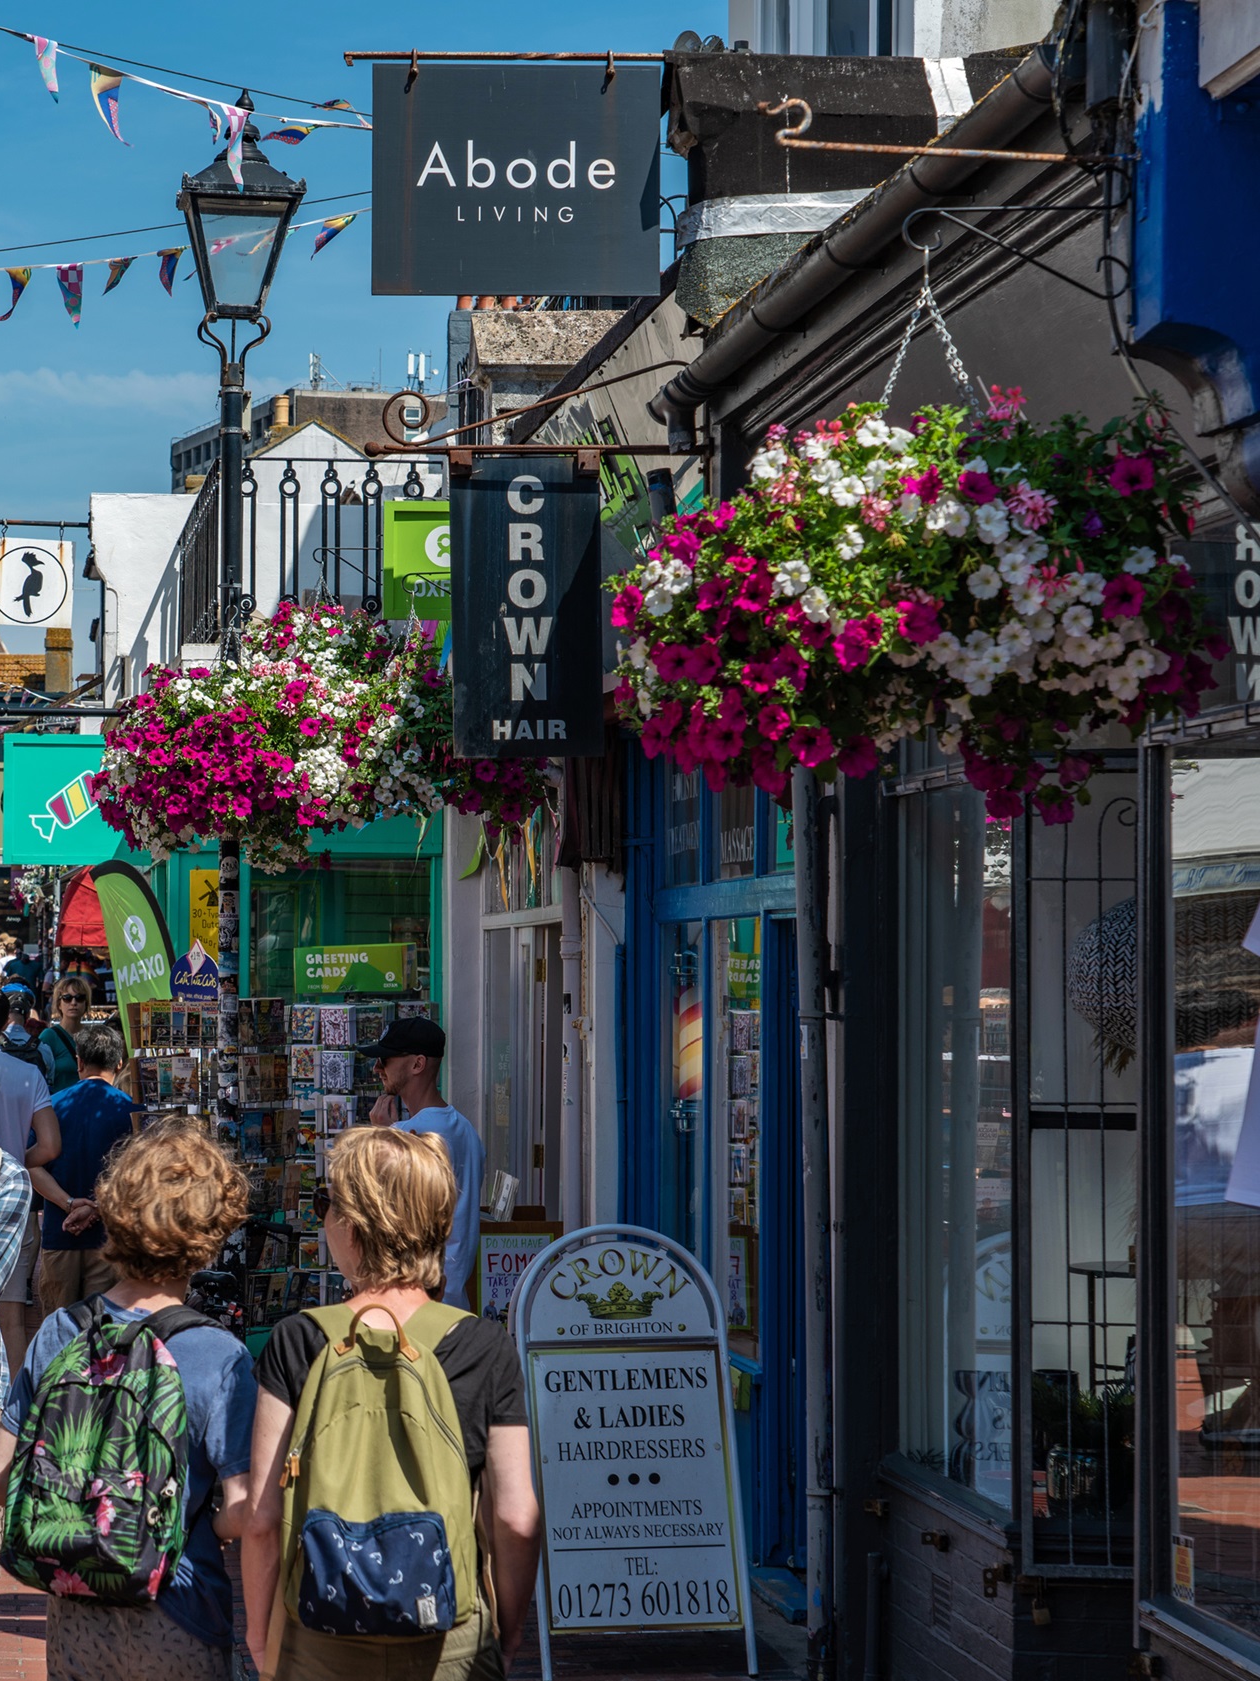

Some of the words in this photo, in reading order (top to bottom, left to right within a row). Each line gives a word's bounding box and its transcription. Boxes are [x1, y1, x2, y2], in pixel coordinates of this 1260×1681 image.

[416, 139, 616, 189] Abode
[457, 206, 574, 223] LIVING
[414, 579, 451, 598] OXF
[503, 475, 553, 700] CROWN
[492, 719, 567, 740] HAIR
[720, 826, 755, 864] MASSAGE
[305, 952, 369, 965] GREETING
[306, 967, 347, 978] CARDS
[486, 1237, 498, 1249] DO
[501, 1237, 518, 1249] YOU
[521, 1237, 543, 1248] HAVE
[486, 1276, 509, 1287] TAKE
[549, 1248, 692, 1300] CROWN
[569, 1323, 589, 1336] OF
[594, 1321, 673, 1335] BRIGHTON
[544, 1366, 708, 1393] GENTLEMENS
[573, 1406, 591, 1429] &
[598, 1404, 685, 1428] LADIES
[557, 1438, 706, 1462] HAIRDRESSERS
[571, 1499, 703, 1519] APPOINTMENTS
[552, 1526, 581, 1541] NOT
[584, 1525, 640, 1540] ALWAYS
[643, 1522, 724, 1538] NECESSARY
[624, 1556, 658, 1576] TEL:
[558, 1582, 632, 1619] 01273
[641, 1579, 730, 1616] 601818
